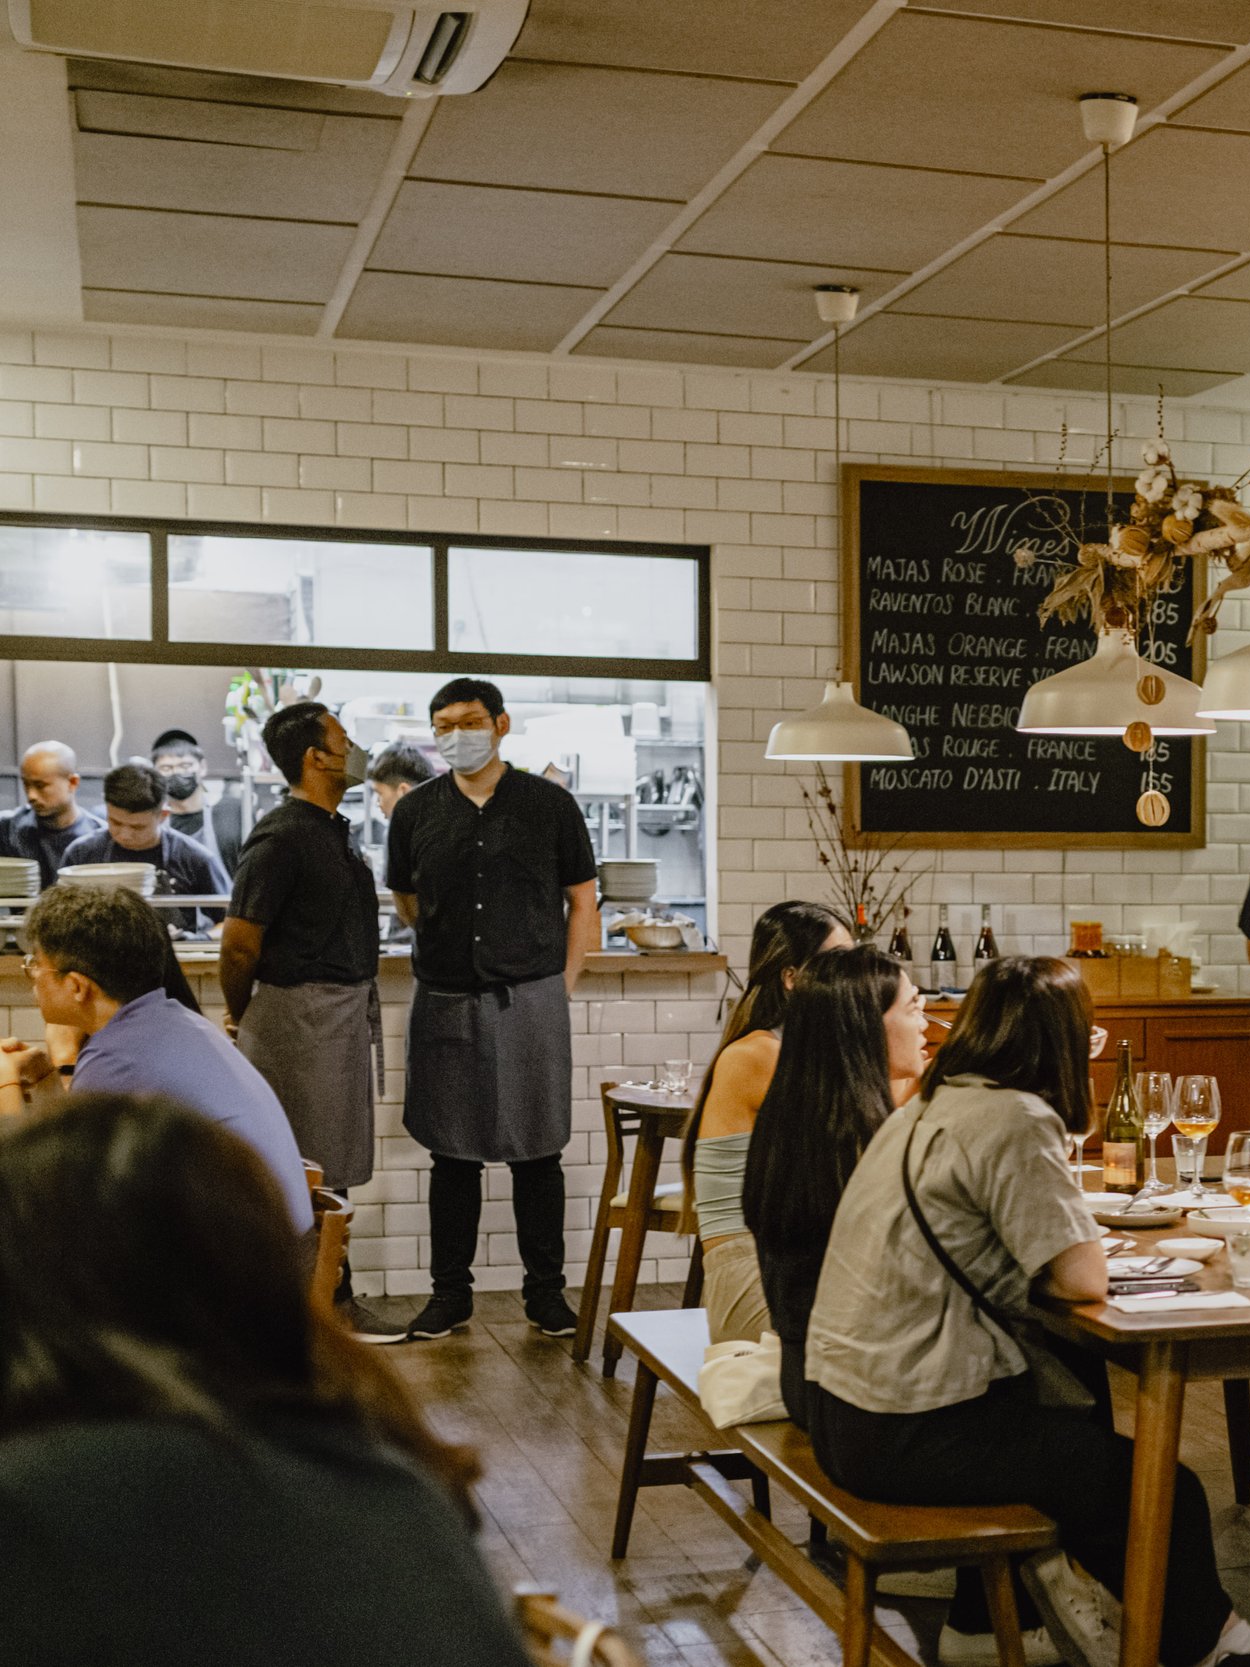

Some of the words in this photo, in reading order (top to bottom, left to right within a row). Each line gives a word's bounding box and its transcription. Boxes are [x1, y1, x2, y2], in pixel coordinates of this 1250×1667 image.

[951, 496, 1070, 556] Wines
[866, 555, 930, 583] MAJAS
[942, 557, 988, 584] ROSE
[869, 588, 955, 615] RAVENTOS
[965, 592, 1020, 616] BLANC
[871, 628, 936, 656] MAJAS
[949, 632, 1028, 659] ORANGE
[1142, 640, 1178, 665] 205
[868, 662, 944, 686] LAWSON
[950, 665, 1021, 688] RESERVE
[942, 734, 1000, 758] ROUGE
[1027, 738, 1097, 761] FRANCE
[870, 767, 953, 791] MOSCATO
[963, 767, 1021, 791] D'ASTI
[1047, 767, 1100, 794] ITALY
